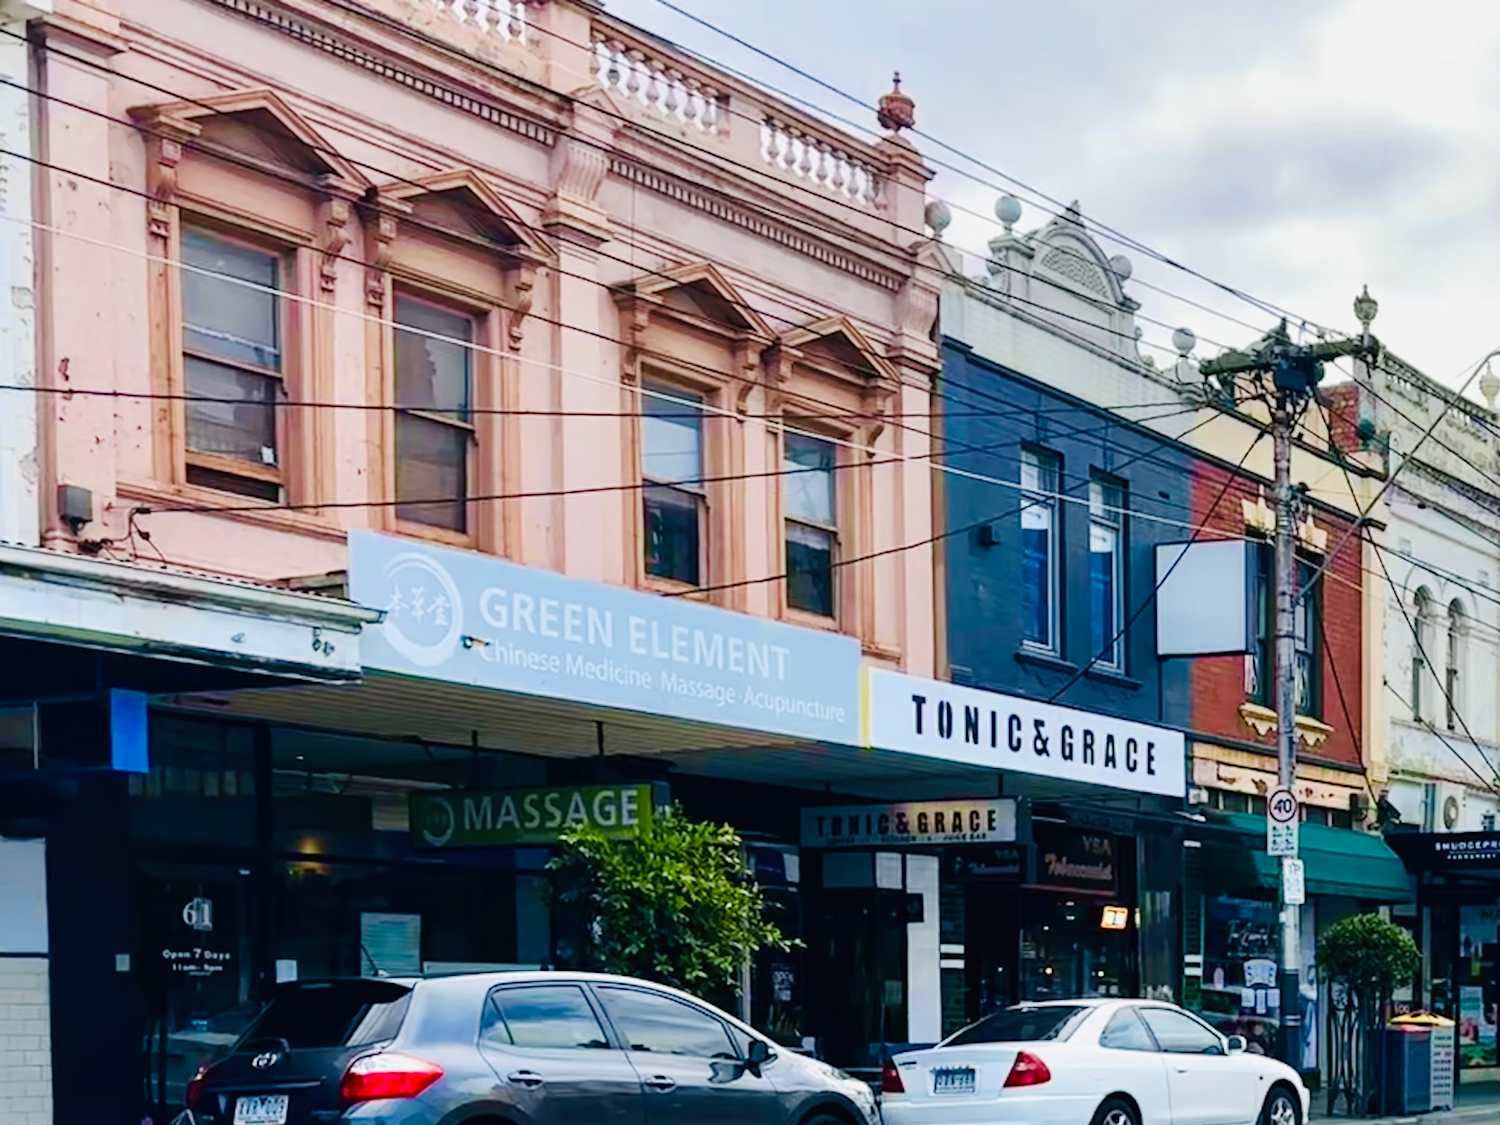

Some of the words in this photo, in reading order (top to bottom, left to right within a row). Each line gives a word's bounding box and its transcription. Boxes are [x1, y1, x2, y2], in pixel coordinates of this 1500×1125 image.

[480, 587, 614, 649] GREEN
[628, 615, 790, 681] ELEMENT
[480, 639, 561, 673] Chinese
[566, 654, 652, 690] Medicine
[661, 671, 736, 707] Massage
[744, 687, 846, 723] Acupuncture
[463, 789, 640, 832] MASSAGE
[1274, 798, 1292, 814] 40
[162, 948, 191, 960] Open
[193, 947, 202, 959] 7
[203, 950, 231, 961] Days
